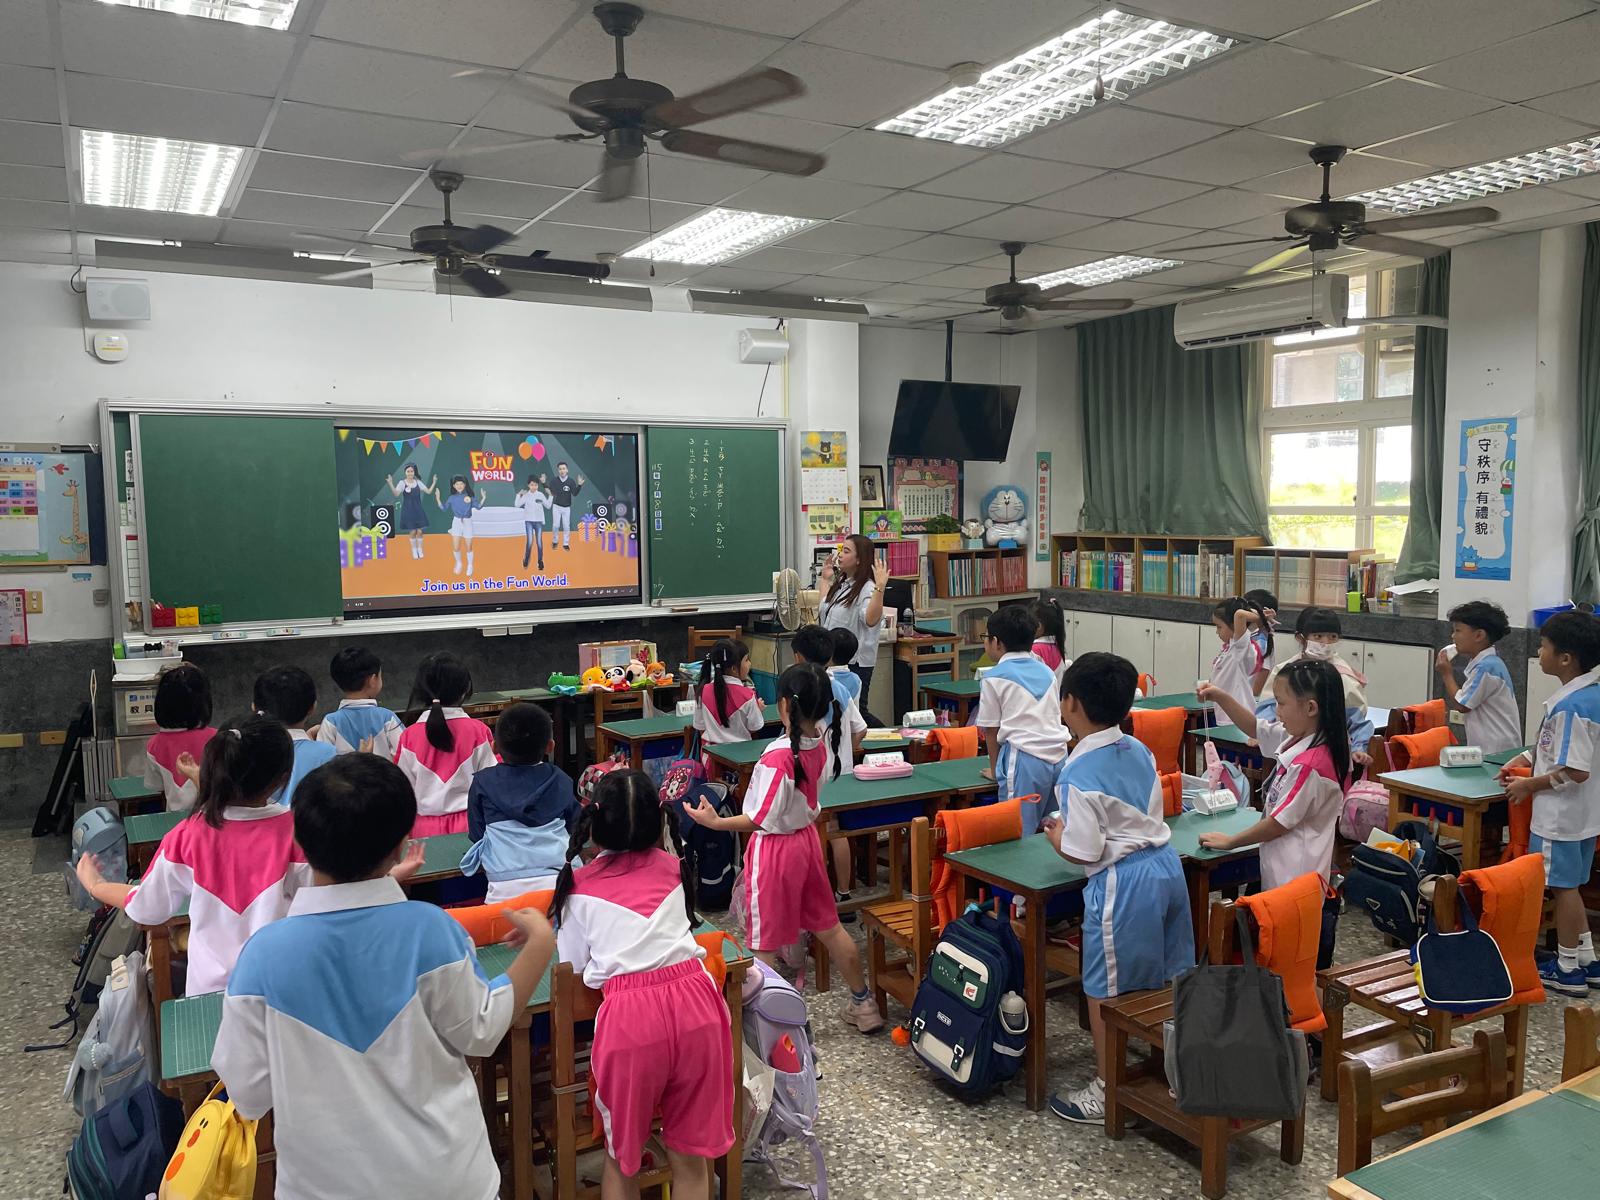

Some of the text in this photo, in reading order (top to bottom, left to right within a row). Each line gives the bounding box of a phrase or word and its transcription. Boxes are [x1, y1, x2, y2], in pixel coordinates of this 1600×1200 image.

[470, 451, 512, 470] FUN
[1476, 438, 1491, 485] 守秩序
[472, 470, 514, 482] WORLD
[1474, 491, 1490, 535] 有禮貌
[420, 579, 448, 593] Join
[452, 583, 466, 591] us
[469, 580, 480, 590] in
[483, 578, 503, 590] the
[507, 576, 529, 588] Fun
[1082, 1100, 1103, 1115] N
